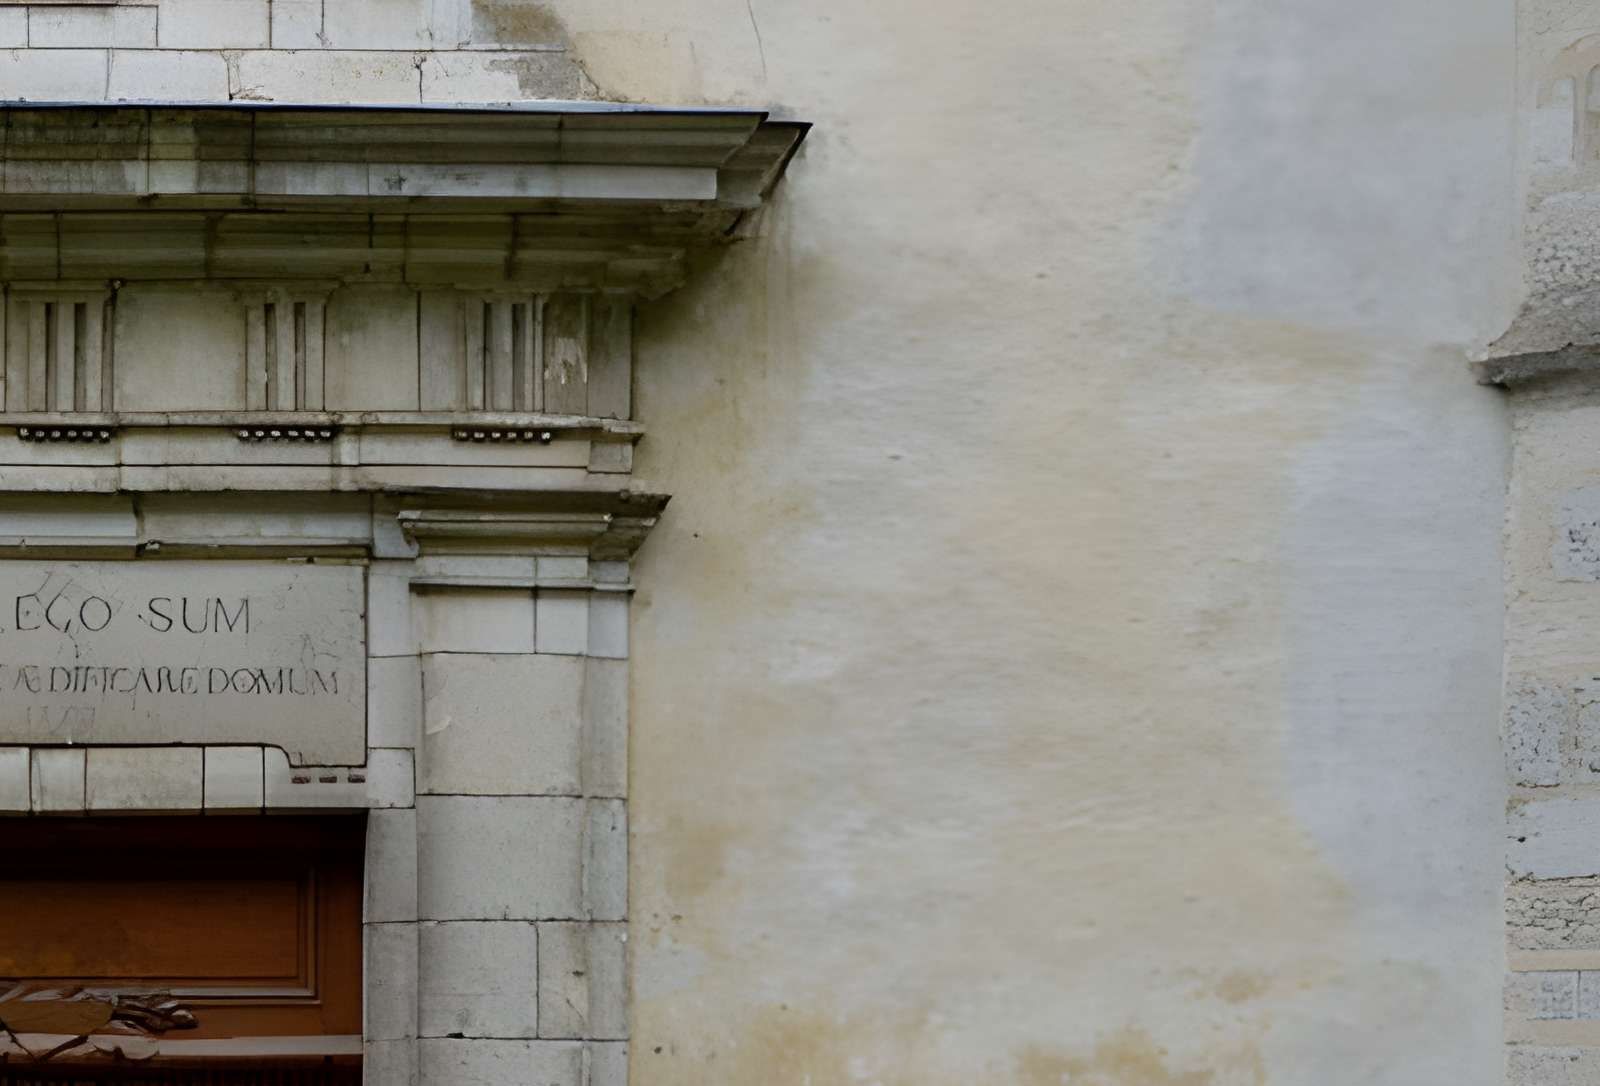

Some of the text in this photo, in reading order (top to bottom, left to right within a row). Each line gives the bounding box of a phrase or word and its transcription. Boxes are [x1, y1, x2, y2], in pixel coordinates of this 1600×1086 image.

[15, 592, 113, 634] EGO
[148, 596, 250, 634] SUM
[207, 667, 339, 695] DOMUM
